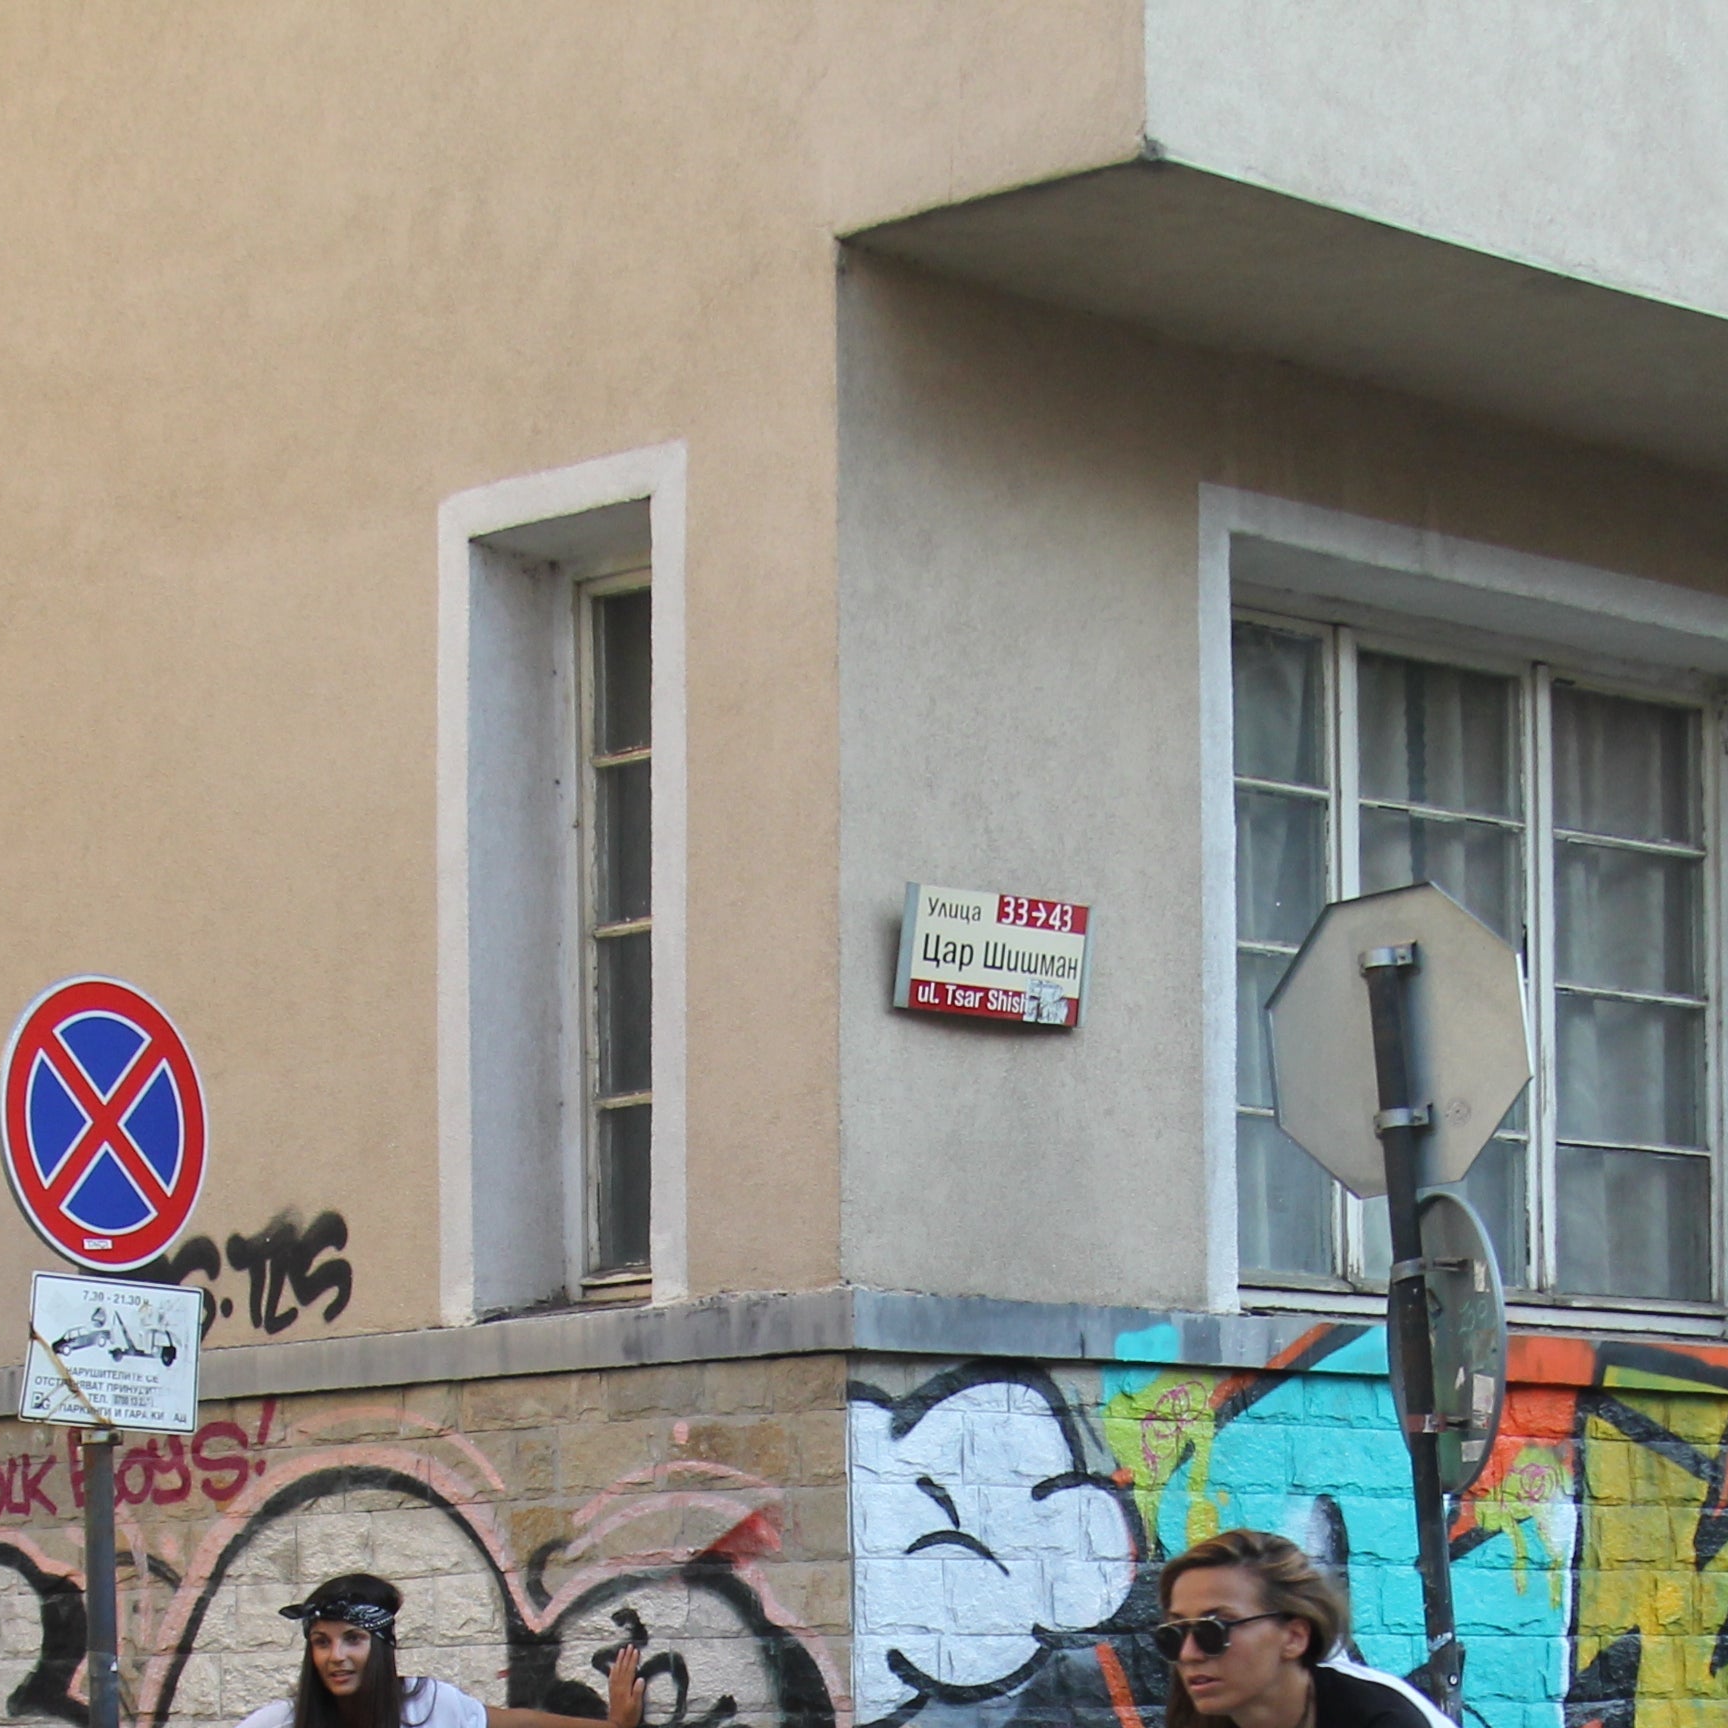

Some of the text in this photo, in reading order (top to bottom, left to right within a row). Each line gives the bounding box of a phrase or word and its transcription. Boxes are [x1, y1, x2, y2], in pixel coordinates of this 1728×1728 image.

[927, 897, 981, 922] Улица
[1001, 896, 1073, 932] 33 43
[922, 933, 1078, 980] Цар Шишман
[917, 982, 940, 1004] ul.
[945, 984, 985, 1009] Tsar
